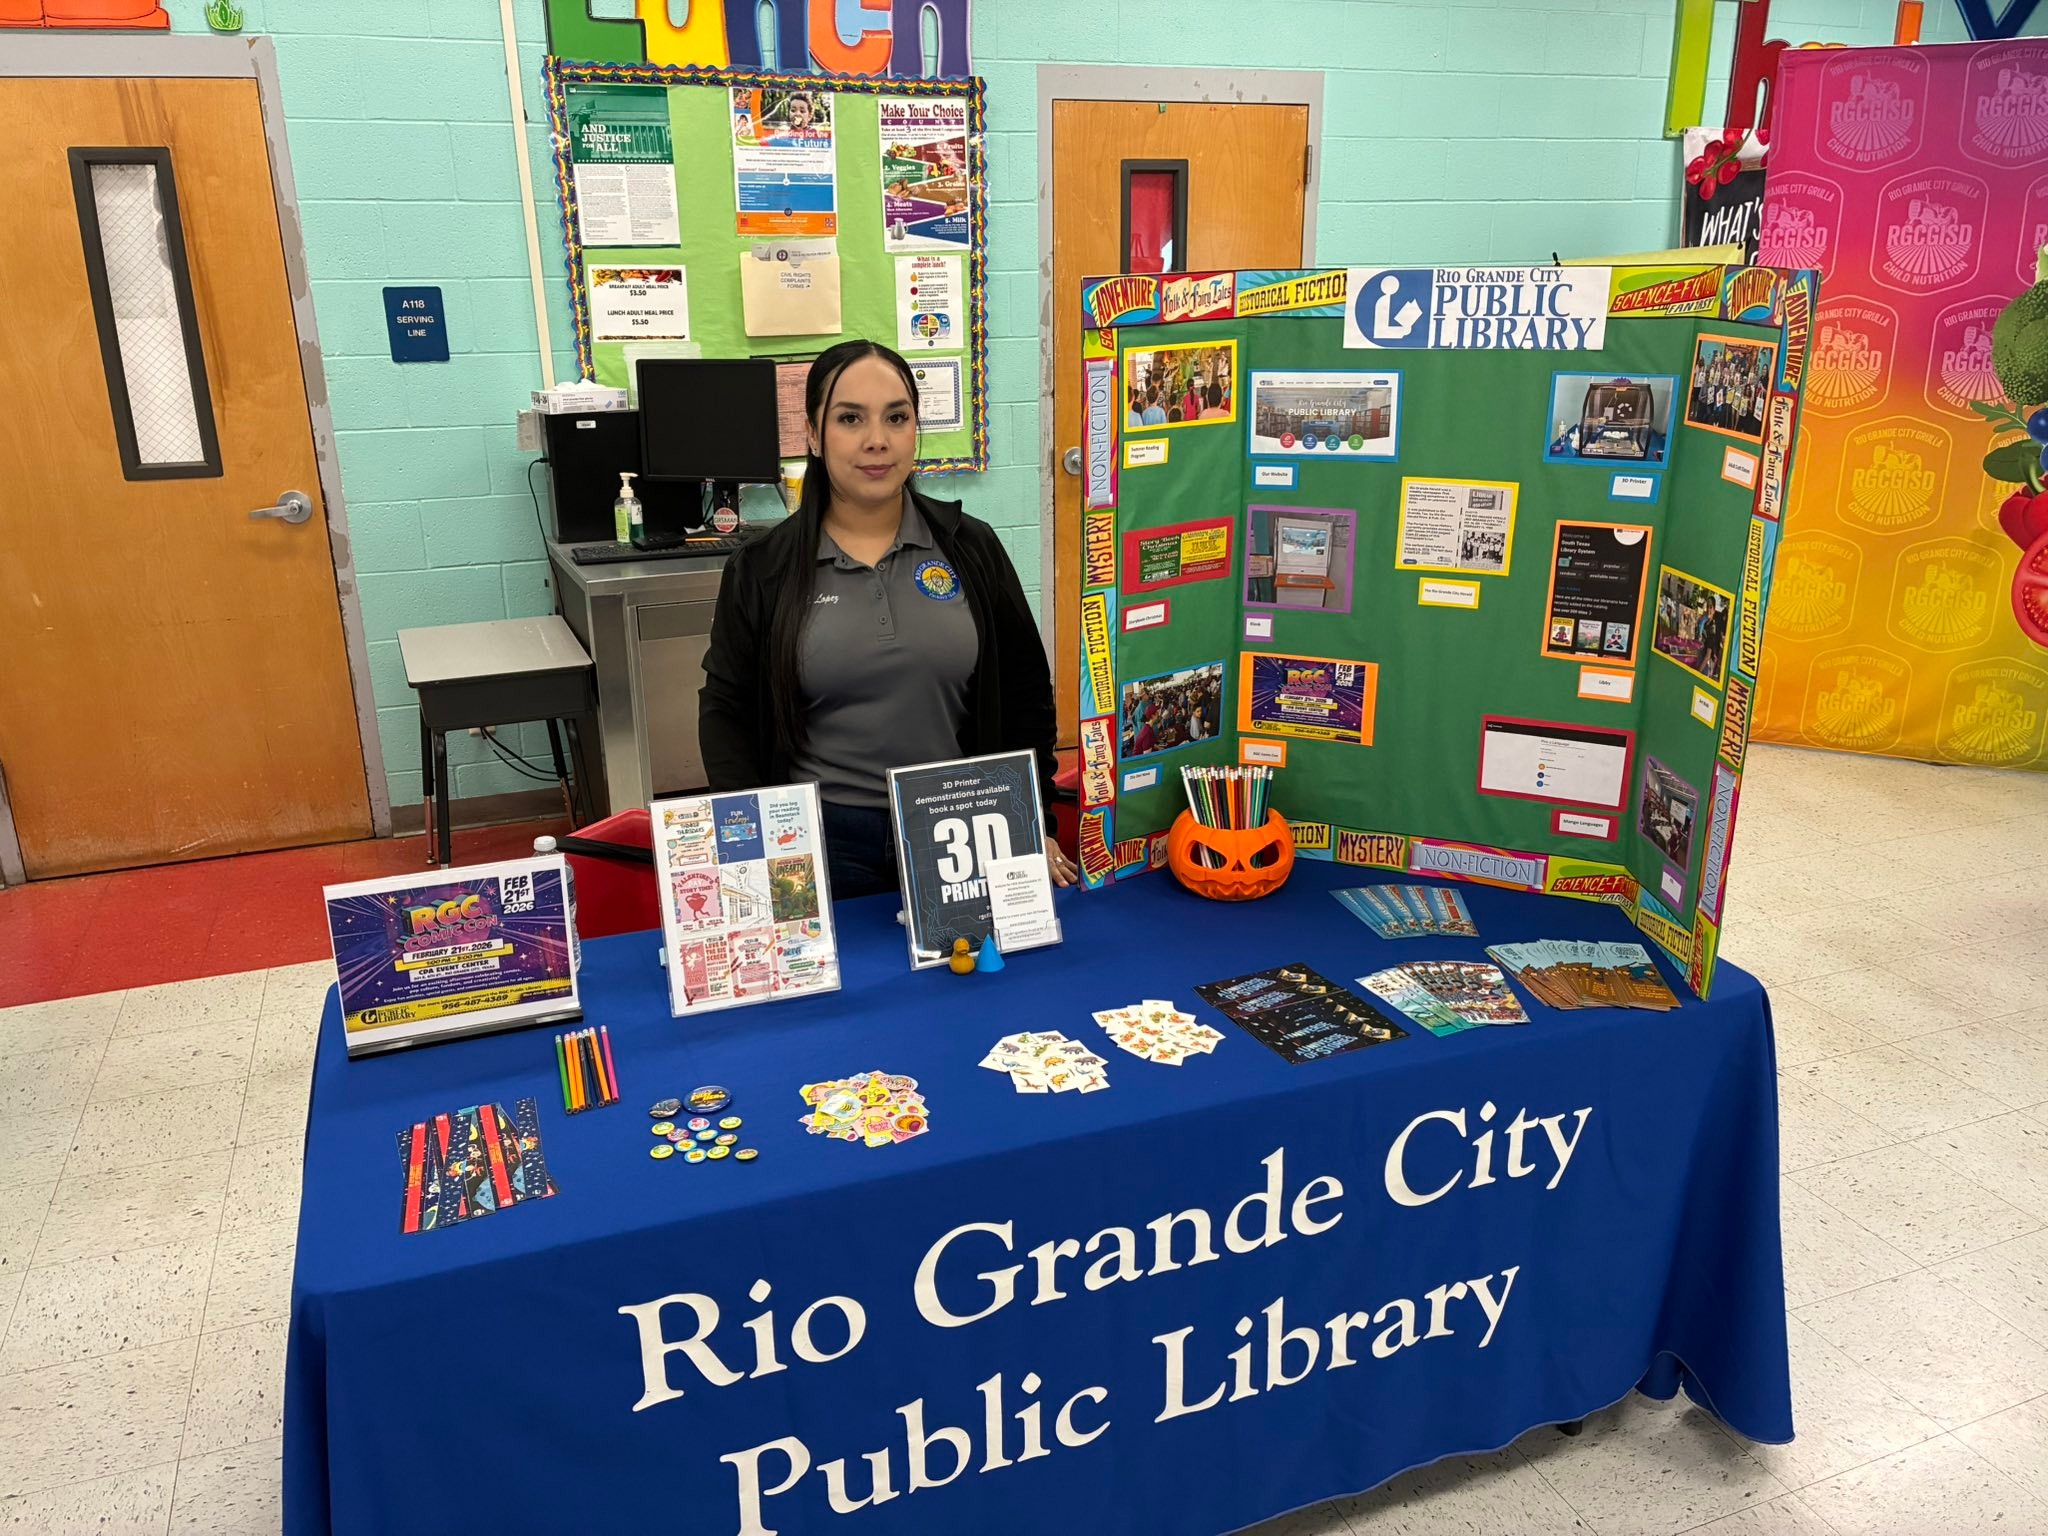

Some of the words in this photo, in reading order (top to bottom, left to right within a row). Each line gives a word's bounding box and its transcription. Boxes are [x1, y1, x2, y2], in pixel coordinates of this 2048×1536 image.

[881, 103, 906, 118] Make
[907, 103, 930, 118] Your
[932, 103, 964, 117] Choice
[1830, 99, 1914, 122] RGCGISD
[581, 124, 607, 133] AND
[581, 133, 632, 143] JUSTICE
[595, 143, 619, 152] ALL
[798, 139, 829, 147] Future
[1826, 138, 1855, 161] CHILD
[1855, 135, 1911, 162] NUTRITION
[891, 164, 916, 172] Veggies
[1886, 223, 1973, 247] RGCGISD
[1435, 268, 1461, 284] RIO
[1466, 268, 1525, 283] GRANDE
[1529, 268, 1563, 283] CITY
[1881, 260, 1911, 284] CHILD
[1911, 260, 1969, 286] NUTRITION
[402, 299, 425, 309] A118
[1094, 277, 1153, 327] ADVENTURE
[1239, 287, 1290, 313] HISTORICAL
[1435, 283, 1573, 318] PUBLIC
[1729, 271, 1776, 316] ADVENTURE
[396, 315, 434, 324] SERVING
[407, 329, 427, 337] LINE
[1432, 317, 1596, 350] LIBRARY
[1782, 290, 1810, 387] ADVENTURE
[1288, 408, 1319, 416] PUBLIC
[1320, 408, 1357, 417] LIBRARY
[1090, 374, 1108, 492] NON-FICTION
[1851, 469, 1936, 492] RGCGISD
[1085, 514, 1114, 587] MYSTERY
[1560, 547, 1577, 555] Library
[1577, 548, 1596, 556] System
[1576, 540, 1591, 548] Texas
[1744, 523, 1763, 592] HISTORICAL
[919, 559, 944, 572] GRANDE
[943, 564, 958, 580] CITY
[814, 593, 840, 605] Lopez
[1084, 599, 1105, 655] FICTION
[1740, 597, 1758, 673] FICTION
[1286, 669, 1326, 685] RGC
[1336, 671, 1352, 680] 21ST
[1337, 664, 1353, 672] FEB
[1091, 656, 1113, 710] HISTORICAL
[1720, 681, 1751, 767] MYSTERY
[1952, 704, 2037, 732] RGCGISD
[914, 789, 976, 805] demonstrations
[975, 783, 1010, 796] available
[942, 782, 953, 790] 3D
[953, 777, 981, 788] Printer
[730, 809, 744, 817] FUN
[780, 805, 800, 814] reading
[928, 804, 949, 815] book
[954, 801, 974, 813] spot
[974, 798, 998, 809] today
[933, 812, 1013, 884] 3D
[1080, 812, 1115, 875] ADVENTURE
[1338, 830, 1404, 868] MYSTERY
[1700, 782, 1731, 906] NON-FICTION
[1424, 845, 1531, 883] NON-FICTION
[503, 875, 528, 891] FEB
[940, 878, 988, 904] PRINT
[503, 888, 530, 904] 21ST
[410, 894, 482, 935] RGC
[503, 903, 535, 914] 2026
[403, 924, 464, 952] COMIC
[462, 914, 498, 933] CON
[412, 948, 449, 960] FEBRUARY
[471, 941, 493, 951] 2026
[436, 964, 460, 973] EVENT
[461, 959, 489, 969] CENTER
[378, 1008, 410, 1018] PUBLIC
[378, 1011, 416, 1023] LIBRARY
[1304, 1048, 1319, 1060] OF
[616, 1279, 868, 1413] Rio
[913, 1146, 1344, 1329] Grande
[1383, 1101, 1594, 1209] City
[718, 1370, 1112, 1536] Public
[1152, 1264, 1521, 1424] Library
